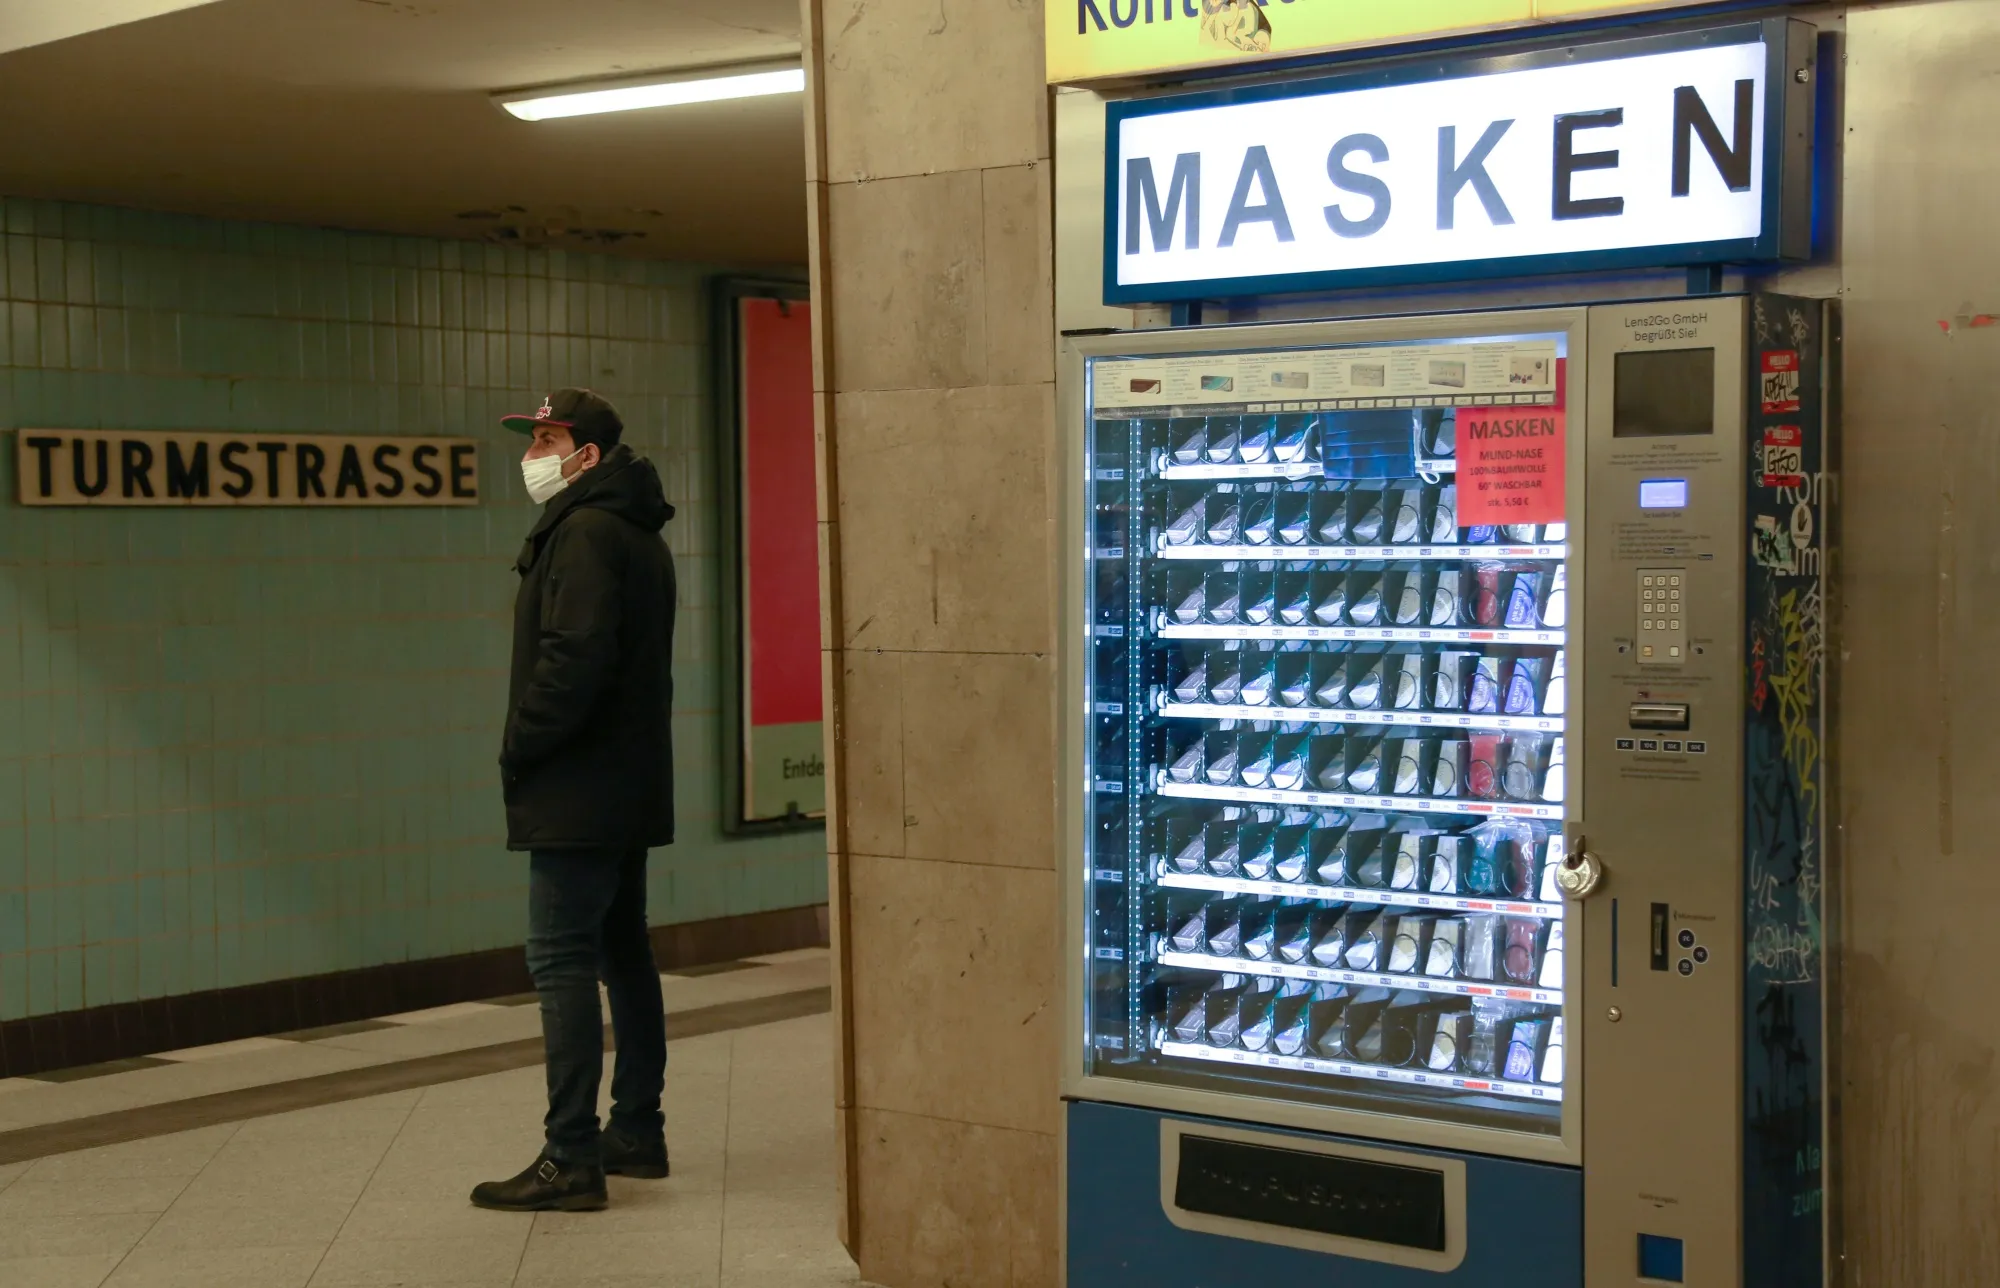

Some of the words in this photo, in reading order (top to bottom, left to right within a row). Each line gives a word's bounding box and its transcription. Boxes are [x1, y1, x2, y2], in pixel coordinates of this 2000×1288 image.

[1126, 78, 1754, 256] MASKEN
[1624, 315, 1671, 328] Lens2Go
[1673, 313, 1708, 325] GmbH
[1634, 329, 1676, 343] begrüßt
[1678, 328, 1698, 339] Sie!
[1769, 355, 1791, 367] HELLO
[1469, 418, 1555, 440] MASKEN
[1772, 430, 1794, 441] HELLO
[1479, 448, 1543, 461] MUND-NASE
[26, 437, 476, 498] TURMSTRASSE
[1494, 480, 1542, 490] WASCHBAR
[1504, 497, 1522, 507] 5,50
[782, 753, 824, 779] Entde
